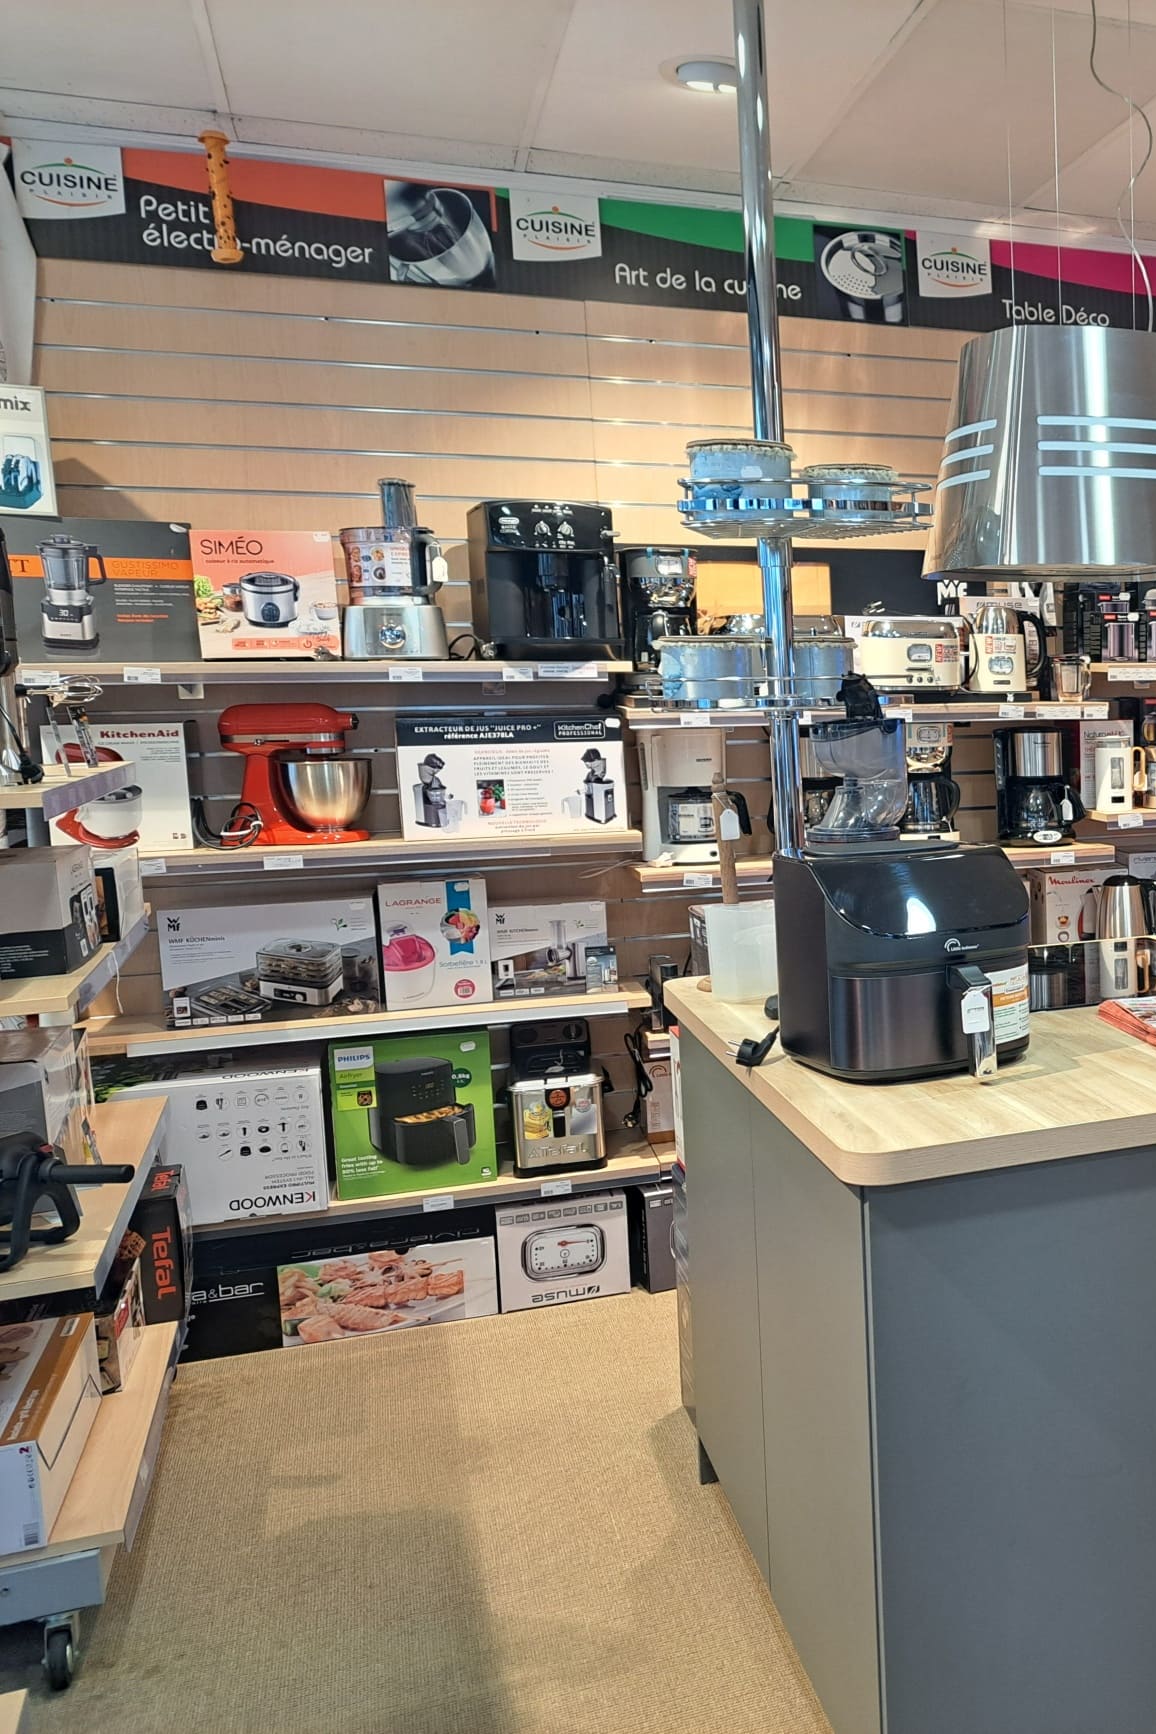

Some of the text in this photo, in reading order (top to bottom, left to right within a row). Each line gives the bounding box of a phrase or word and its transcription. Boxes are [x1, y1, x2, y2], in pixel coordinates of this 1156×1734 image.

[20, 170, 118, 192] CUISINE
[139, 194, 210, 224] Petit
[516, 218, 595, 237] CUISINE
[142, 223, 373, 268] élect-ménager
[921, 257, 988, 276] CUISINE
[615, 263, 802, 300] Art de la cune
[1001, 298, 1110, 327] Table Déco
[200, 535, 263, 556] SIMÉO
[100, 730, 179, 738] KitchenAid
[385, 897, 442, 907] LAGRANGE
[336, 1053, 370, 1064] PHILIPS
[151, 1170, 178, 1192] Tefal
[229, 1191, 316, 1211] KENWOOD
[151, 1225, 176, 1300] Tefal
